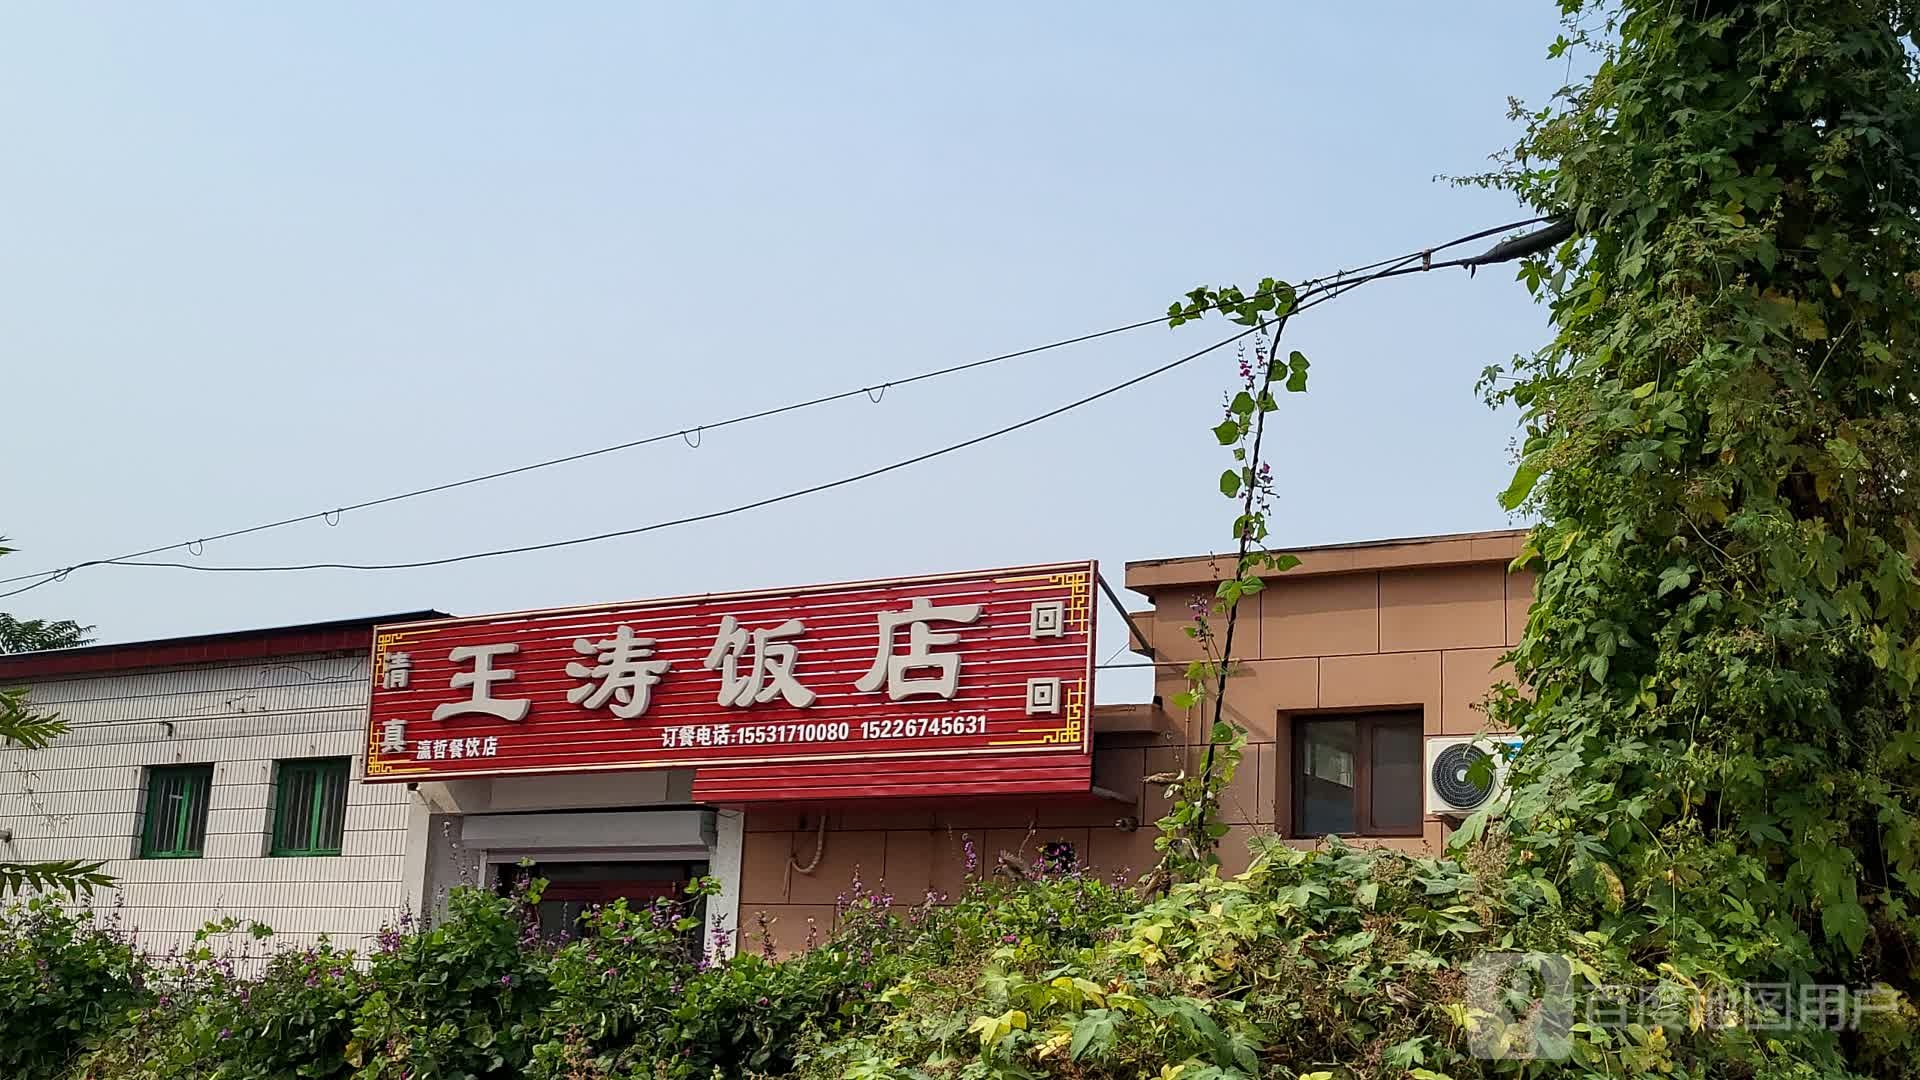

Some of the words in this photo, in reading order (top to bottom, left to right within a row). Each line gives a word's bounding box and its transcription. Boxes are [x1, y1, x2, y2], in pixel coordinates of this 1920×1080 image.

[381, 652, 412, 754] 清真
[432, 597, 983, 720] 王涛饭店
[860, 715, 987, 739] 15226745631
